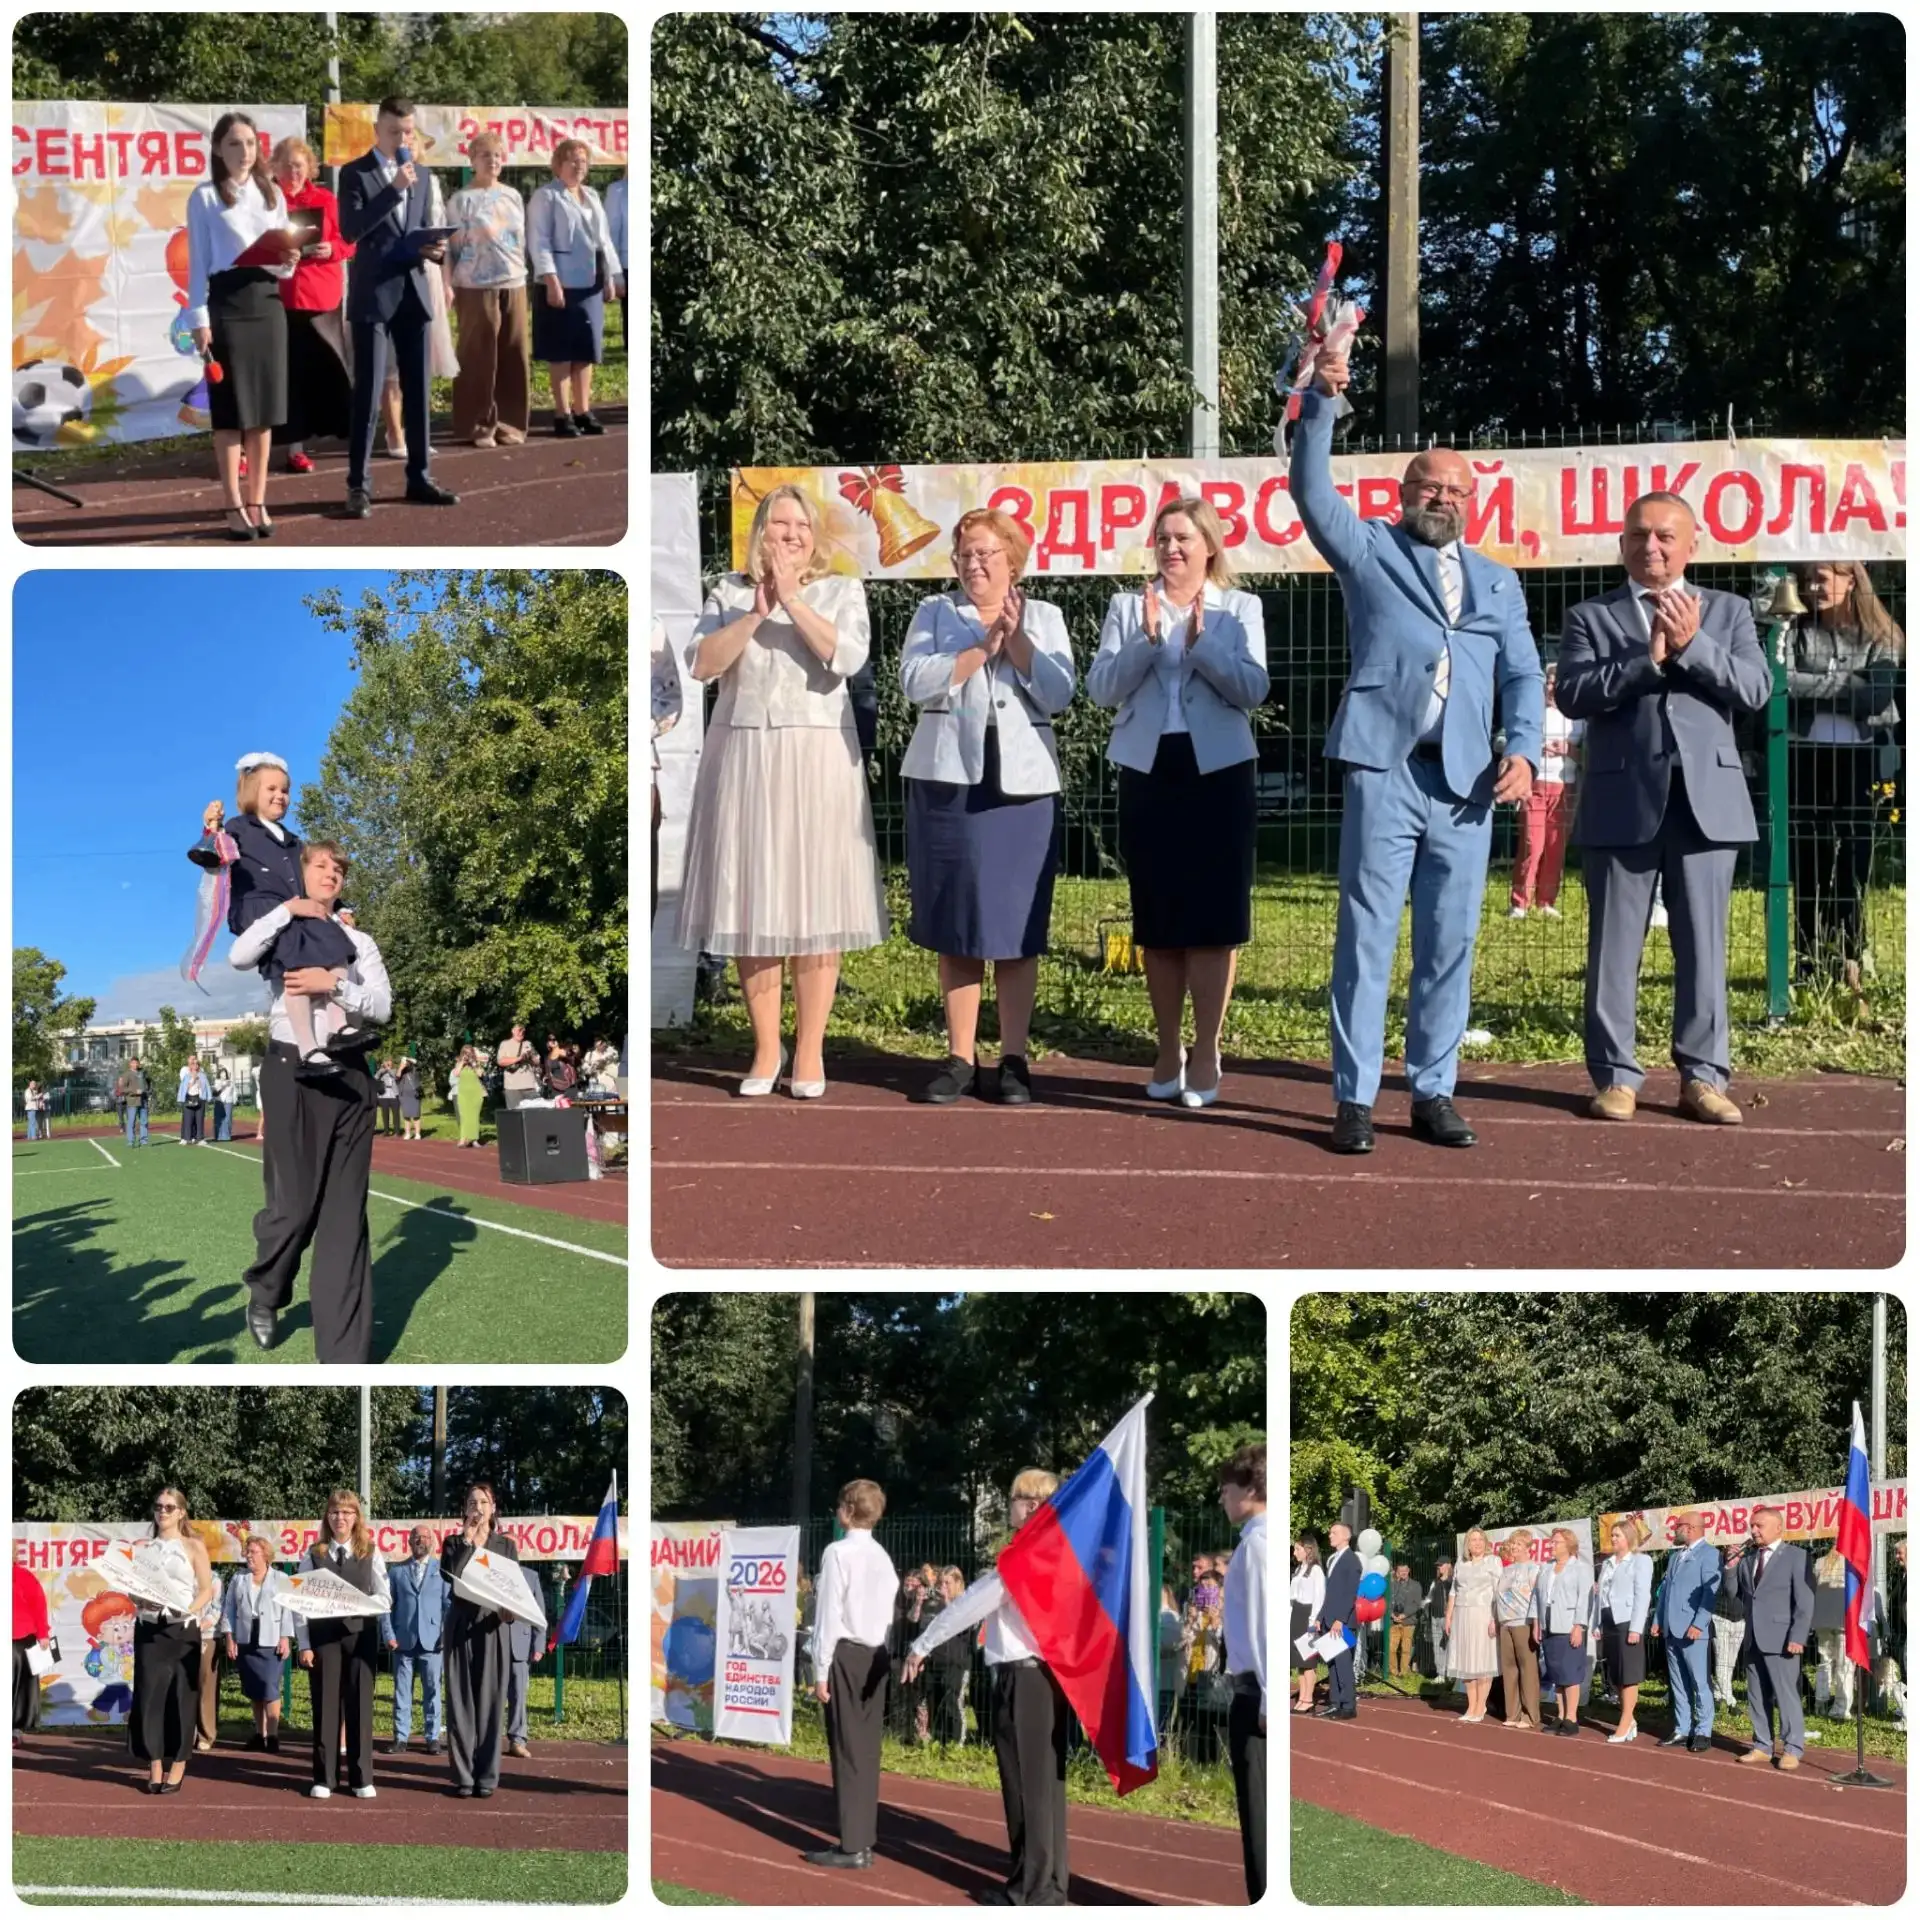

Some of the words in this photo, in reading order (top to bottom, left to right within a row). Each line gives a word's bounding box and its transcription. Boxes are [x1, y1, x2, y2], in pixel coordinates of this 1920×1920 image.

[12, 124, 272, 180] СЕНТЯБ
[730, 1560, 787, 1586] 2026
[726, 1661, 747, 1672] ГОД
[725, 1671, 781, 1685] ЕДИНСТВА
[725, 1683, 776, 1697] НАРОДОВ
[725, 1694, 769, 1706] РОССИИ
